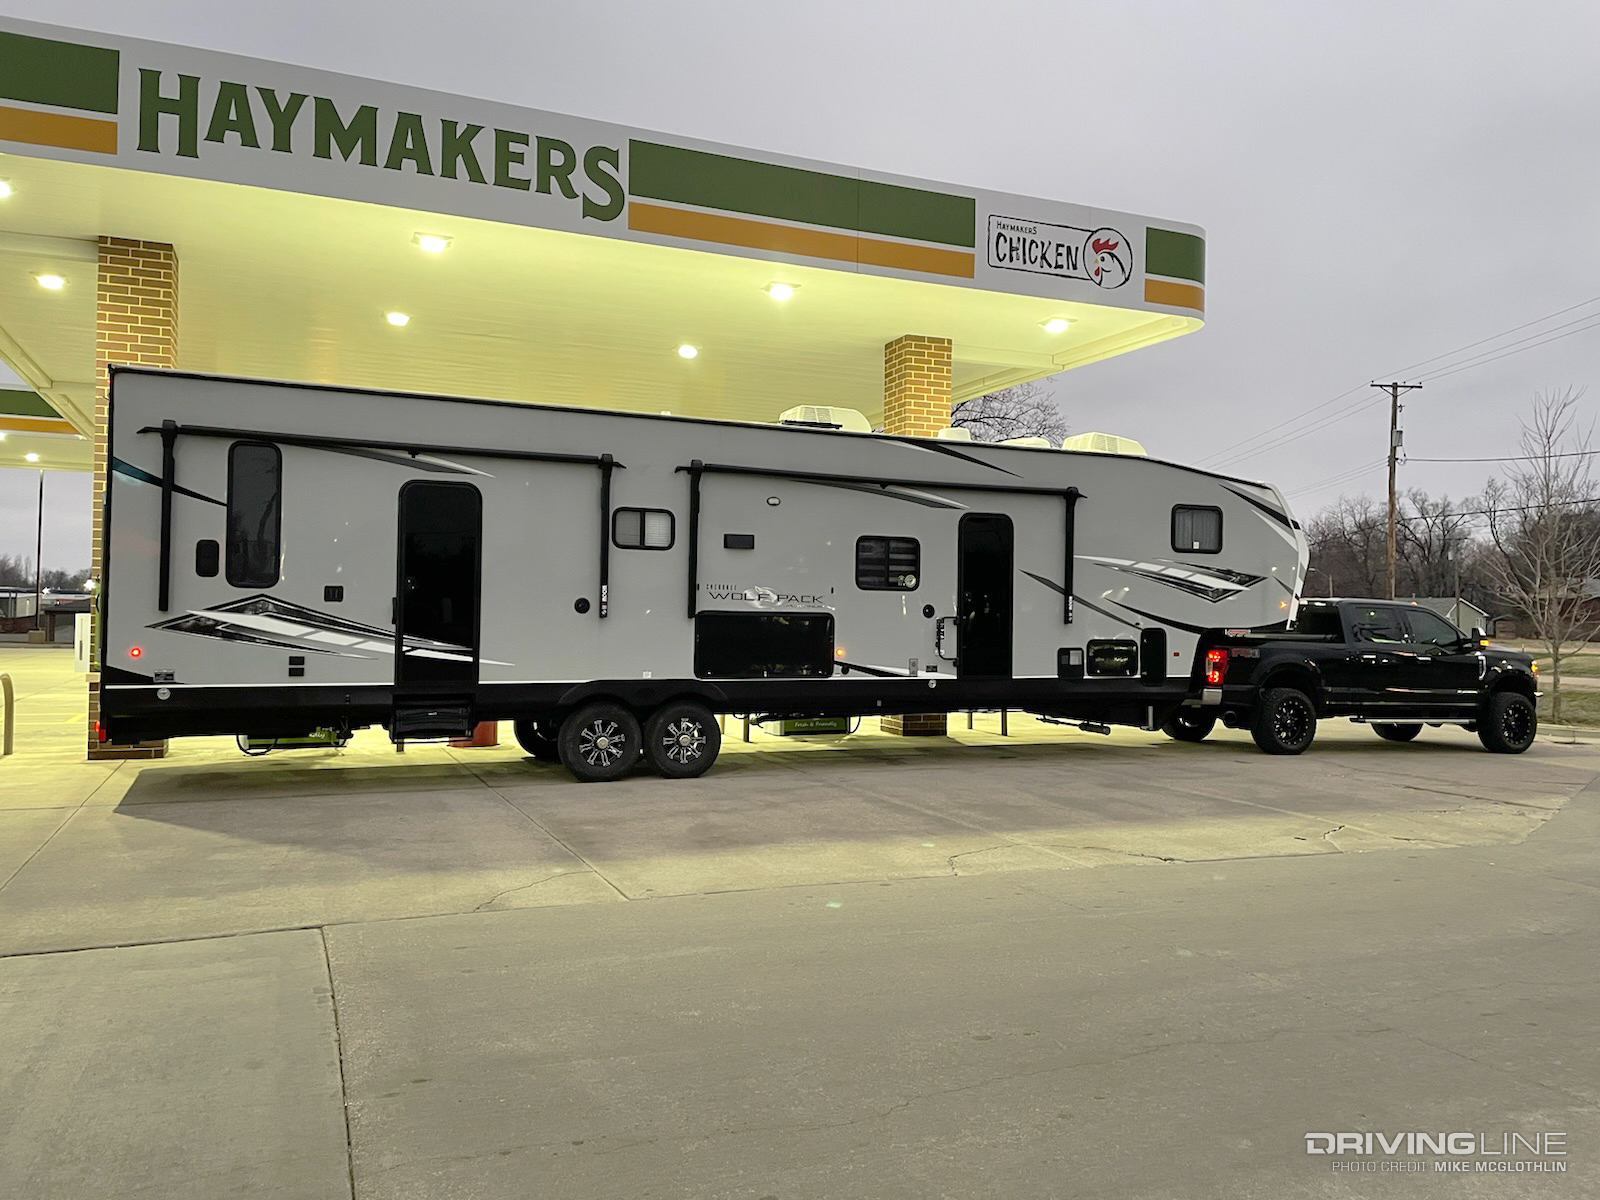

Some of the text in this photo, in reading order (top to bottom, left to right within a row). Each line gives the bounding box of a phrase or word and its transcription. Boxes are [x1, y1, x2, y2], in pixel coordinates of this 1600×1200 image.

[137, 68, 626, 222] HAYMAKERS
[996, 221, 1037, 235] HAYMAKERS
[995, 231, 1079, 271] CHICKEN
[776, 594, 824, 604] PACK
